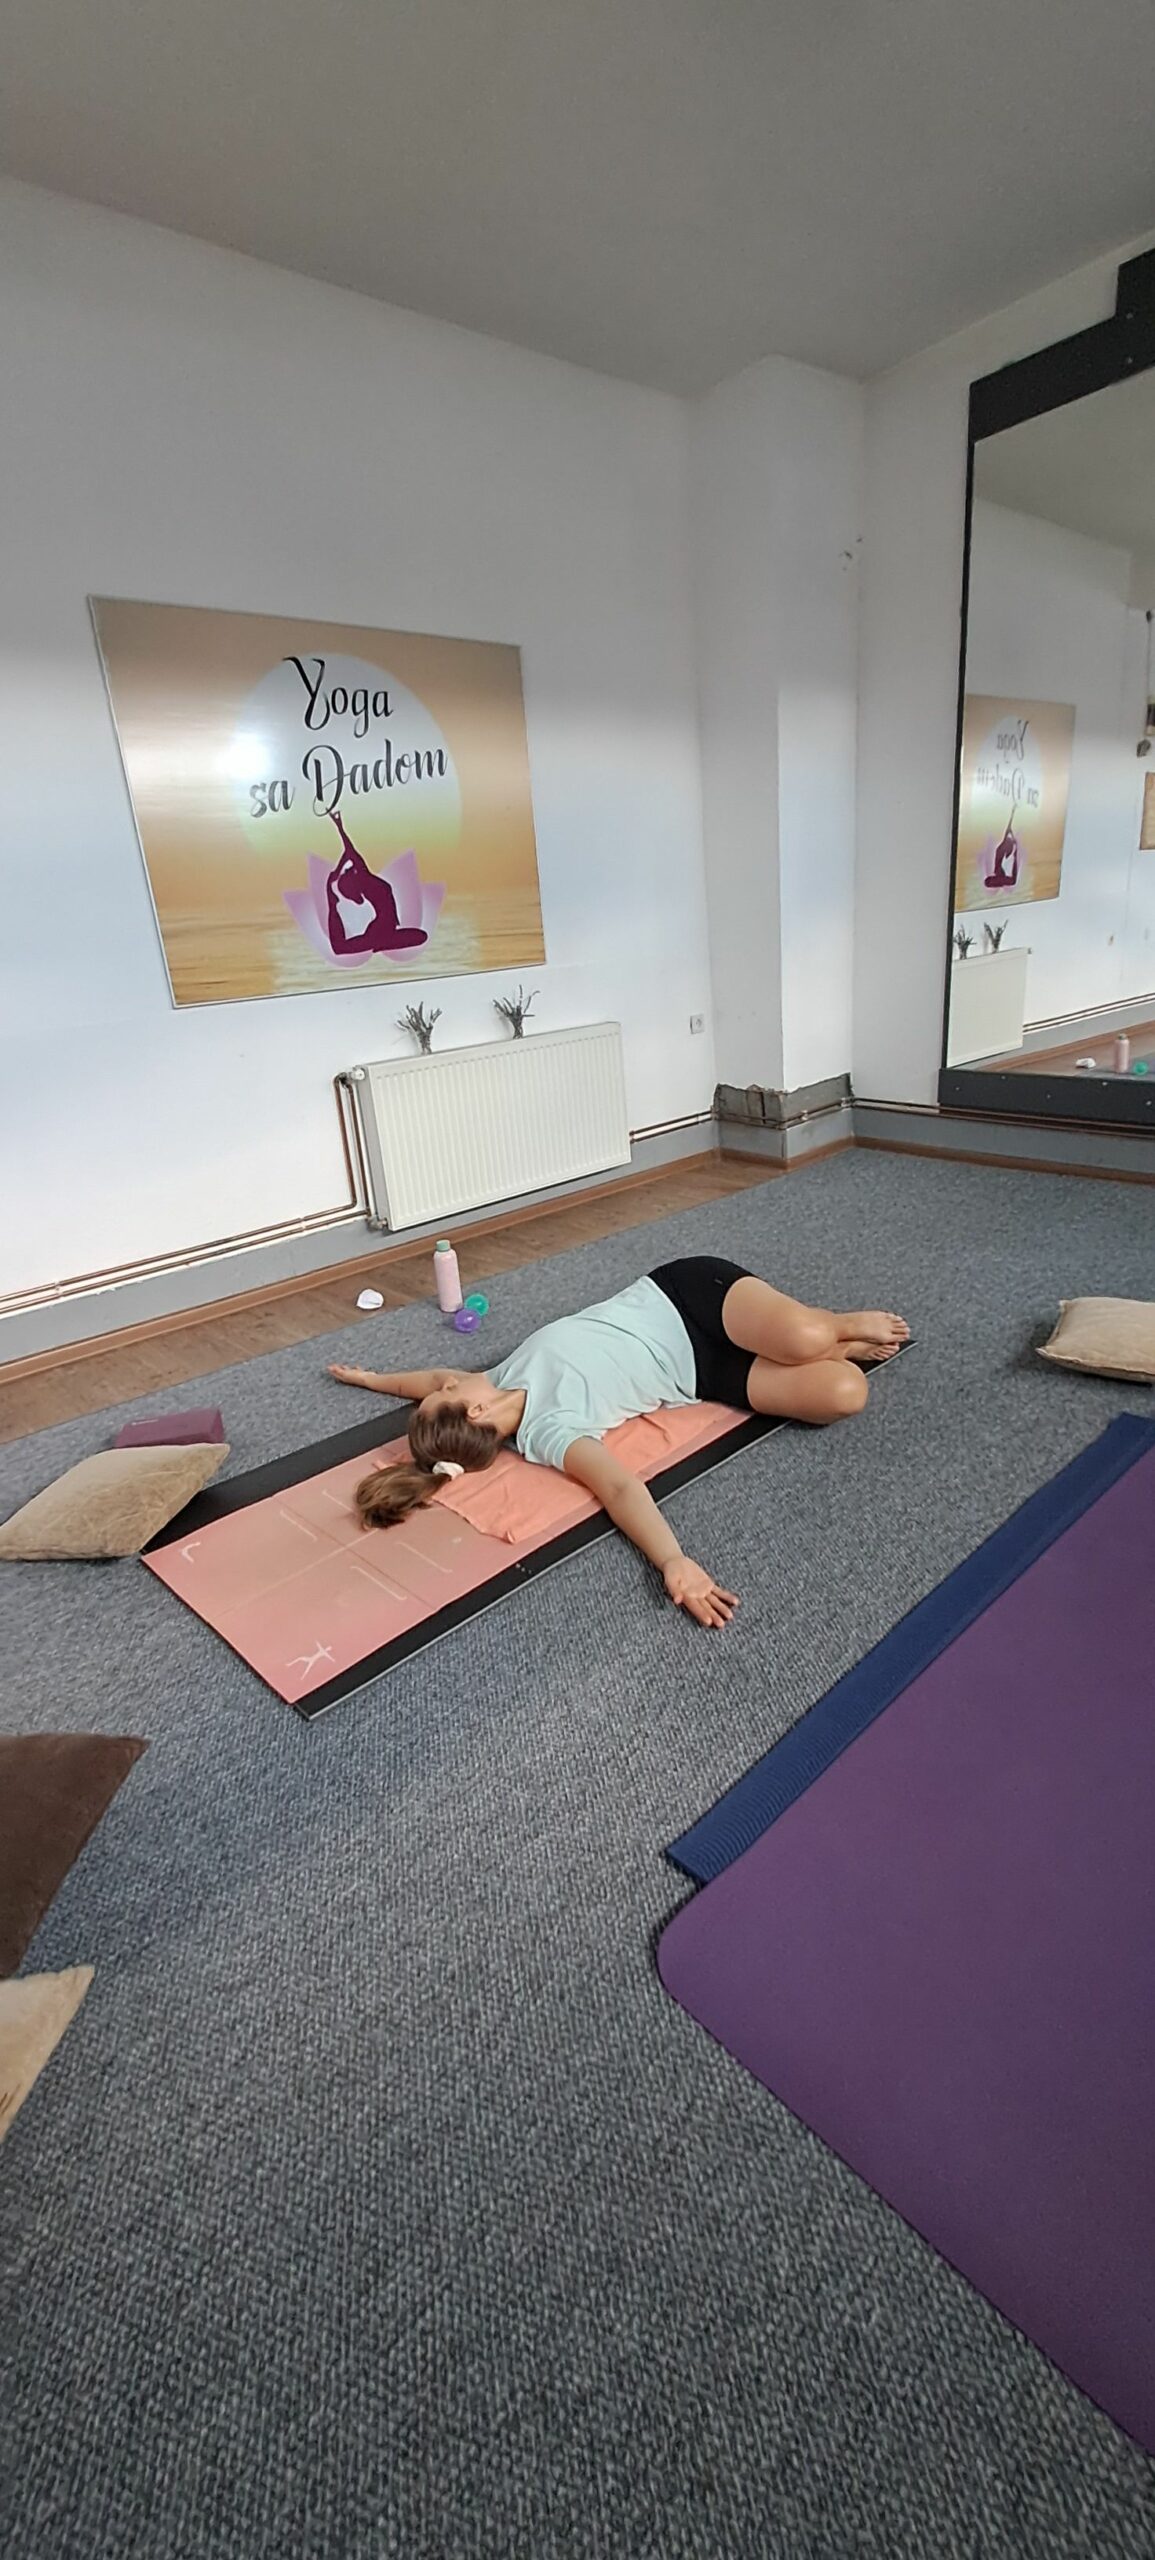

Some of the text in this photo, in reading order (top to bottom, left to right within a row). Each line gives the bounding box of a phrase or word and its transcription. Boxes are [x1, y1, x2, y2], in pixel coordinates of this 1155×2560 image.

[282, 656, 394, 739] Yoga
[249, 738, 448, 818] sa Dadom
